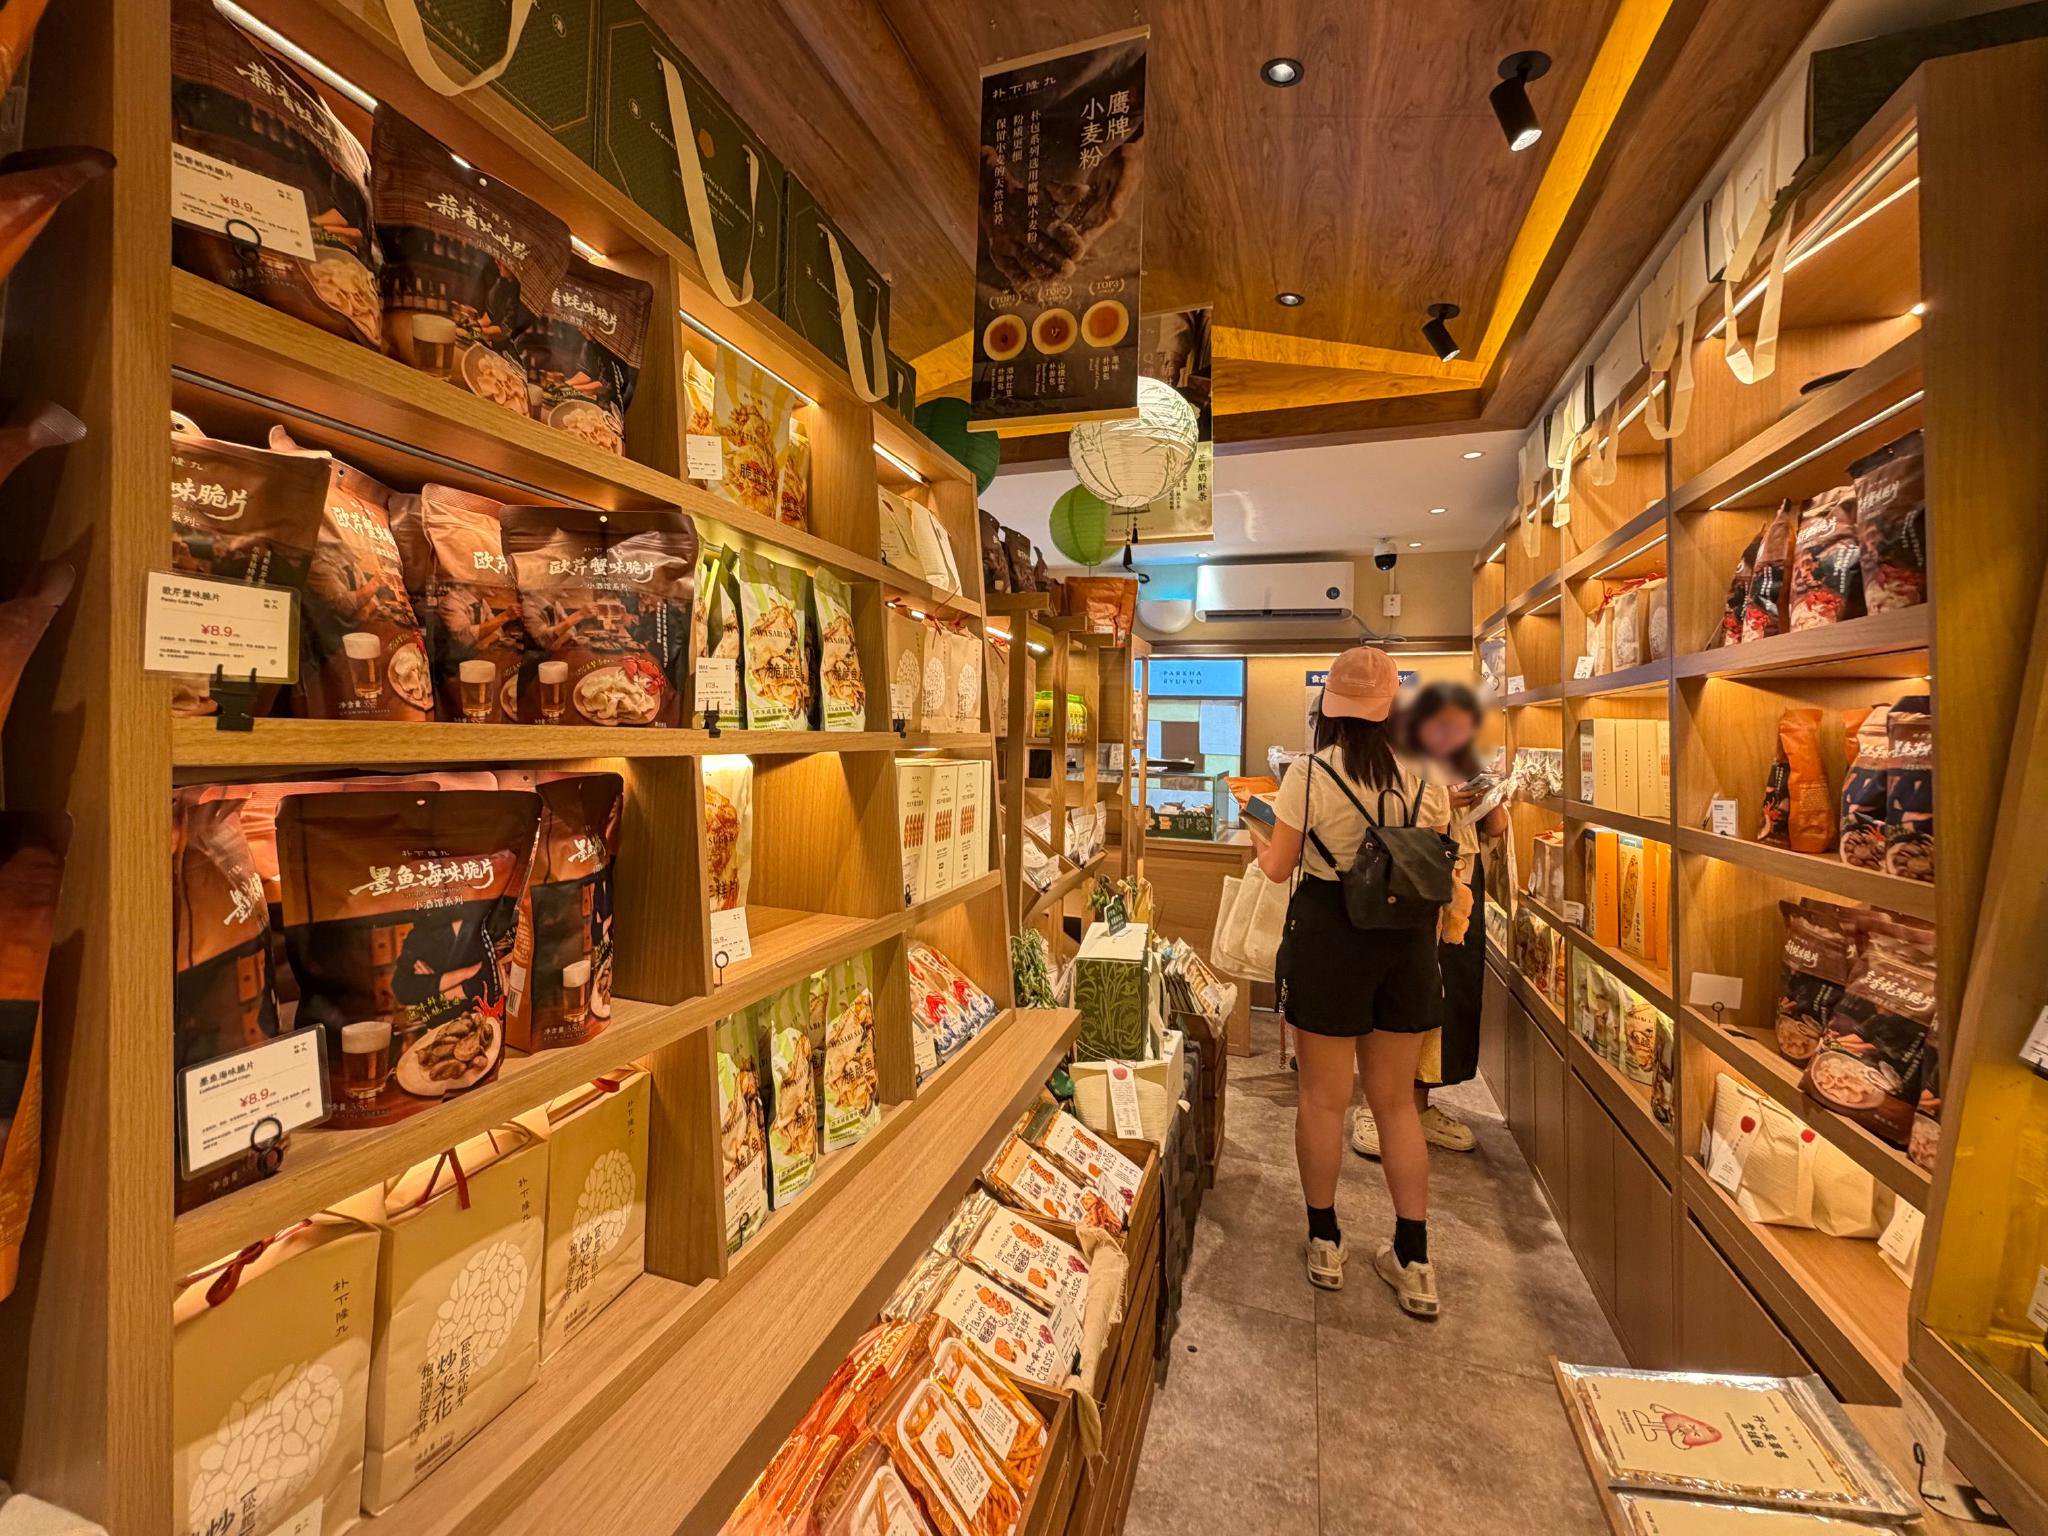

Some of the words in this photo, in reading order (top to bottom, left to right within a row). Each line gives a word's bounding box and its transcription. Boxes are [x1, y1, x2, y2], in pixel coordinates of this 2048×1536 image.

[1106, 90, 1132, 141] 鹰牌
[1079, 97, 1105, 170] 小麦粉
[219, 193, 254, 212] ¥8.9
[1096, 280, 1119, 290] TOP3
[549, 557, 656, 584] 欧芹蟹味脆片
[201, 624, 233, 637] ¥8.9
[349, 858, 495, 897] 墨鱼海味脆片
[413, 895, 464, 911] 小酒馆系列
[239, 1088, 269, 1107] ¥8.9
[573, 1234, 593, 1295] 炒米花
[1001, 1240, 1021, 1266] Flavor
[333, 1277, 351, 1338] 朴下隆九
[965, 1306, 986, 1335] Flavor
[1036, 1349, 1056, 1381] Classic
[430, 1349, 457, 1426] 炒米花
